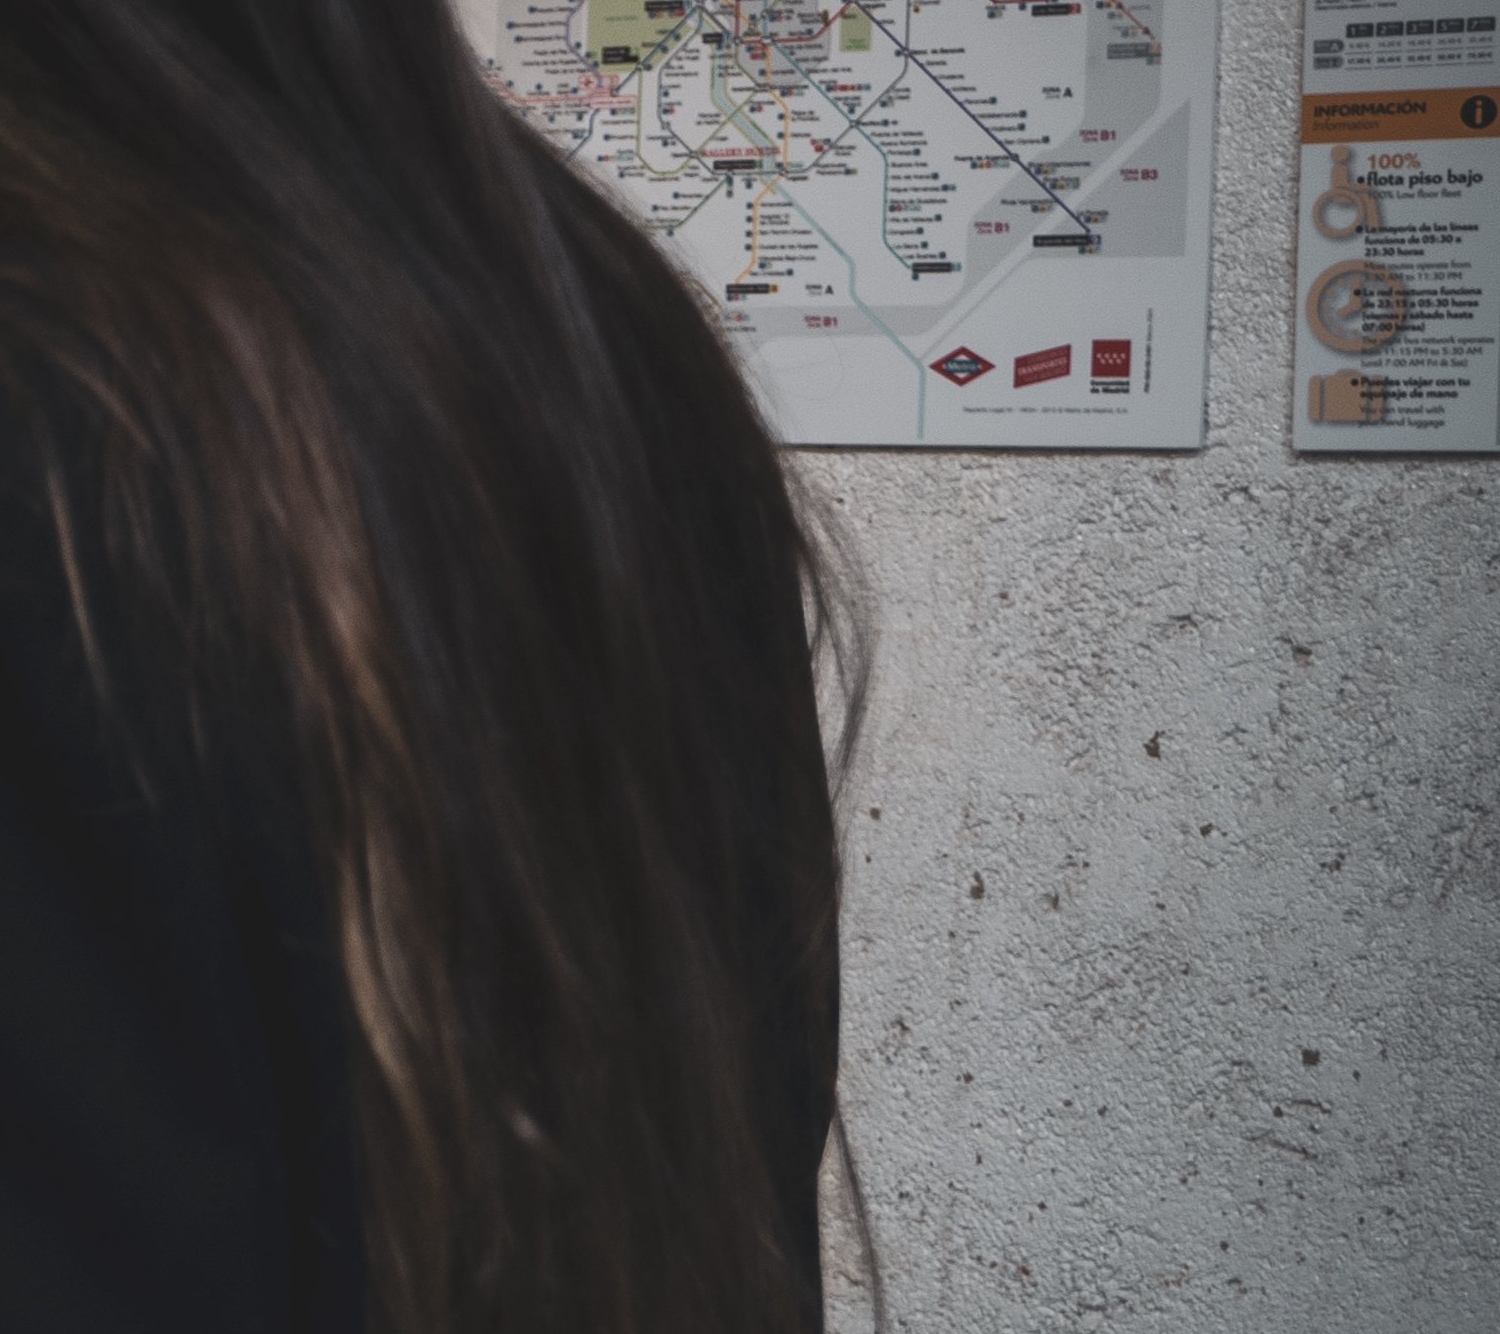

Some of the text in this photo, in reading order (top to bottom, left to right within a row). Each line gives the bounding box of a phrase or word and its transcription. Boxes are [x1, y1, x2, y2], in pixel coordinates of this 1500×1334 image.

[1063, 87, 1073, 98] A
[1313, 100, 1427, 117] INFORMACIÓN
[1100, 130, 1116, 141] B1
[1367, 153, 1421, 170] 100%
[1140, 169, 1158, 180] B3
[1367, 168, 1483, 189] flota piso bajo
[994, 222, 1010, 233] B1
[825, 285, 834, 295] A
[823, 316, 837, 326] B1
[1403, 376, 1433, 389] viajar
[1435, 378, 1455, 387] con
[1458, 377, 1470, 386] tu
[1409, 389, 1423, 398] de
[1426, 390, 1458, 398] mano
